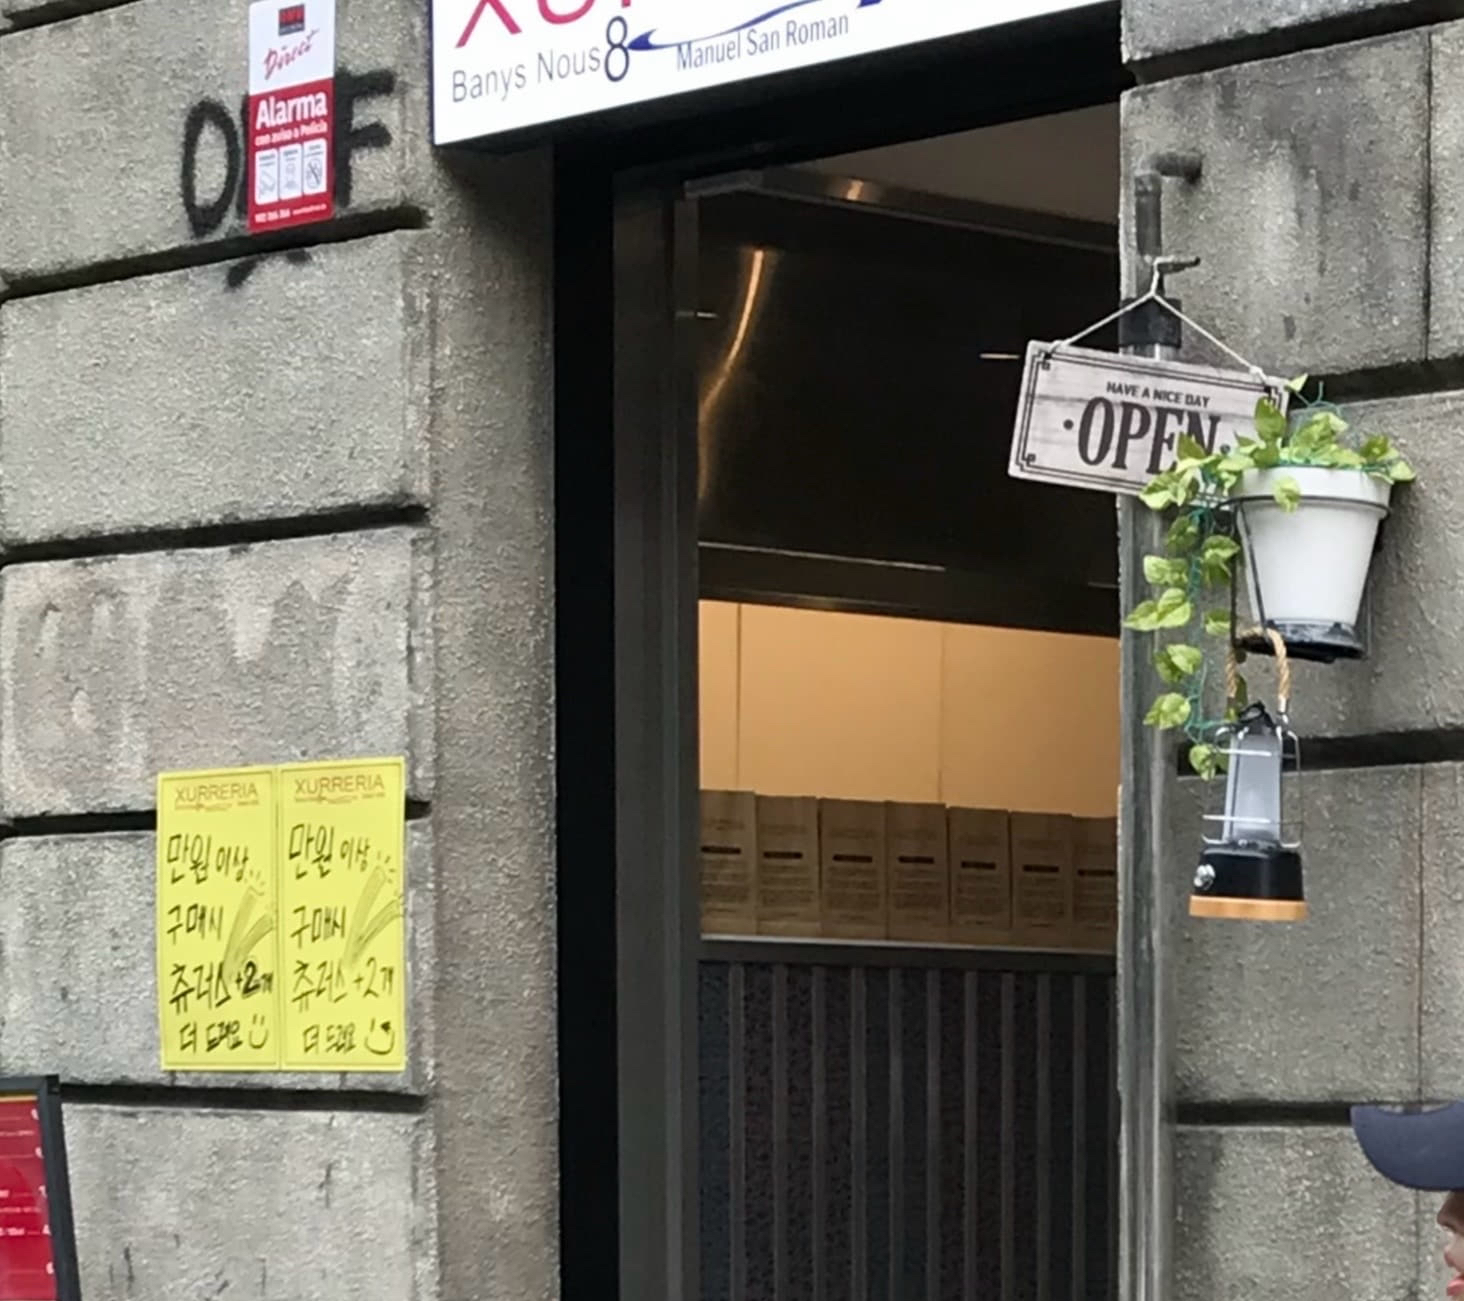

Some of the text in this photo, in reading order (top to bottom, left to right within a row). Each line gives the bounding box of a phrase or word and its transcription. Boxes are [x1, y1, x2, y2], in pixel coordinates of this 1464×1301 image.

[452, 63, 527, 103] Banys
[537, 46, 601, 84] Nous
[604, 15, 630, 83] 8
[676, 14, 849, 72] Manuel San Roman
[256, 91, 329, 130] Alarma
[1106, 381, 1211, 408] HAVE A NICE DAY
[1078, 396, 1221, 475] OPEN
[175, 782, 259, 802] XURRERIA
[295, 774, 385, 796] XURRERIA
[166, 833, 249, 884] 만원 이상
[288, 823, 371, 880] 만원 이상
[166, 903, 224, 945] 구매시
[290, 905, 347, 949] 구매시
[179, 1020, 197, 1054] 더
